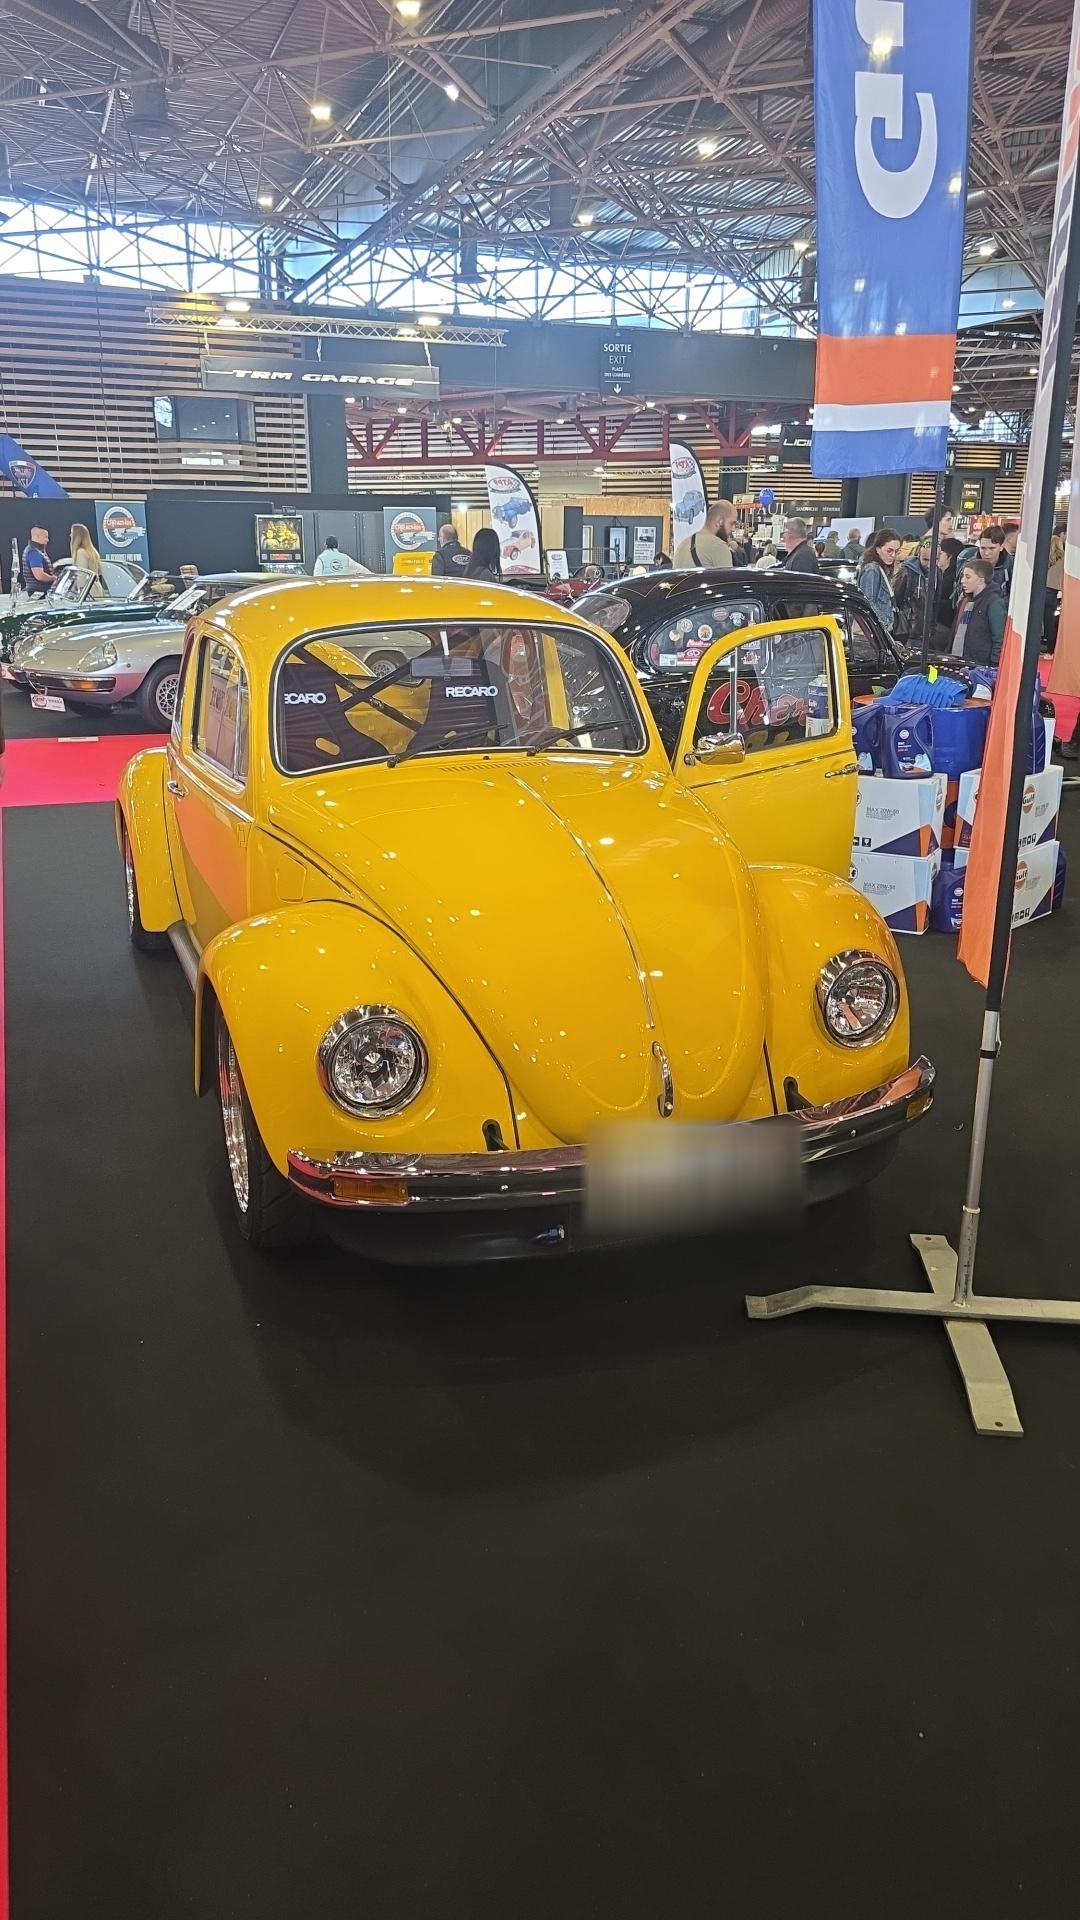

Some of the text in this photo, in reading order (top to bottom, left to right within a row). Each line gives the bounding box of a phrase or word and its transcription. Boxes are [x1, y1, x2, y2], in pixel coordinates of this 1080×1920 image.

[603, 343, 632, 353] SORTIE
[609, 355, 627, 365] EXIT
[232, 369, 415, 386] TRM GARAGE
[445, 685, 499, 698] RECARO
